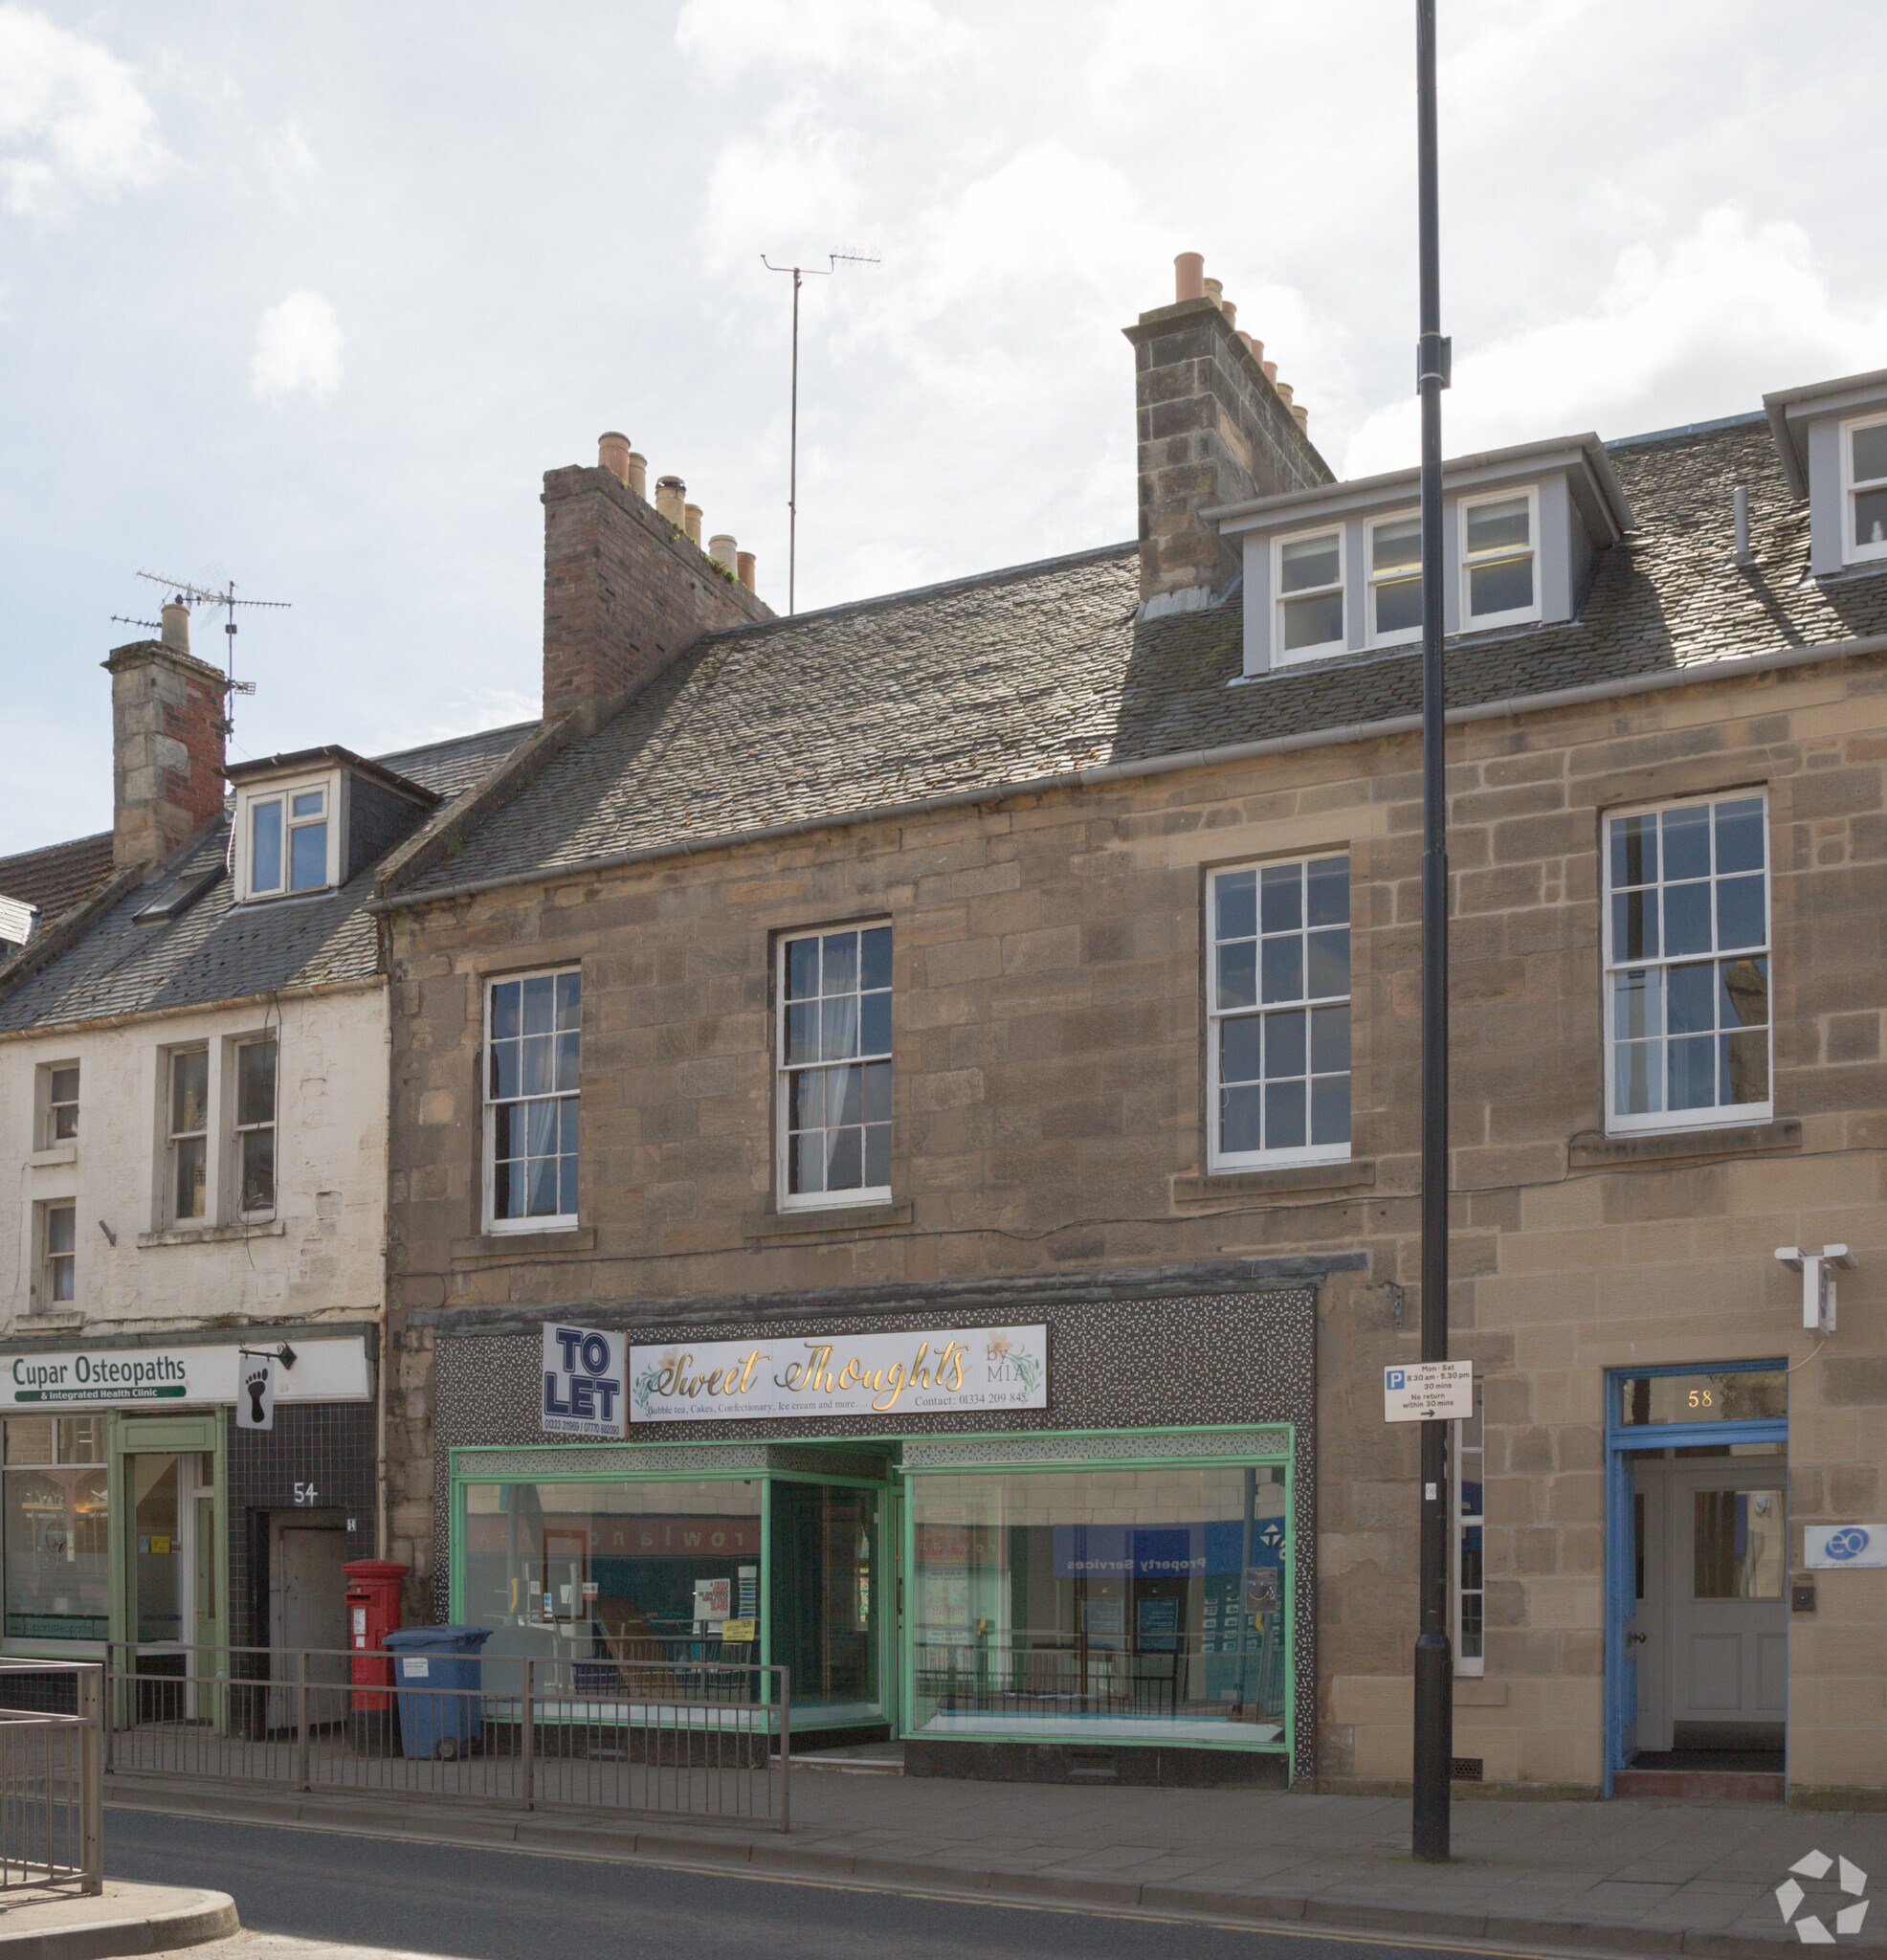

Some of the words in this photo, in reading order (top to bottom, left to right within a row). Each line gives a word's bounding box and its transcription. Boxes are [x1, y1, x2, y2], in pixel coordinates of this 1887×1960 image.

[556, 1327, 610, 1376] TO
[987, 1345, 1008, 1364] by
[12, 1357, 68, 1389] Cupar
[75, 1355, 186, 1386] Osteopaths
[647, 1349, 772, 1398] Sweet
[774, 1340, 972, 1411] Thoughts
[987, 1365, 1027, 1382] MIA
[41, 1392, 48, 1400] &
[50, 1391, 99, 1401] Integrated
[100, 1389, 130, 1398] Health
[132, 1388, 158, 1397] Clinic
[544, 1371, 620, 1421] LET
[915, 1394, 956, 1407] Contact:
[959, 1393, 986, 1405] 01334
[988, 1392, 1006, 1404] 209
[1010, 1392, 1027, 1403] 845
[1688, 1390, 1713, 1408] 58
[648, 1406, 672, 1414] Bubble
[674, 1406, 688, 1414] tea,
[690, 1404, 716, 1414] Cakes,
[718, 1402, 776, 1414] Confectionary,
[778, 1401, 789, 1411] Ice
[818, 1399, 832, 1409] and
[294, 1482, 319, 1505] 54
